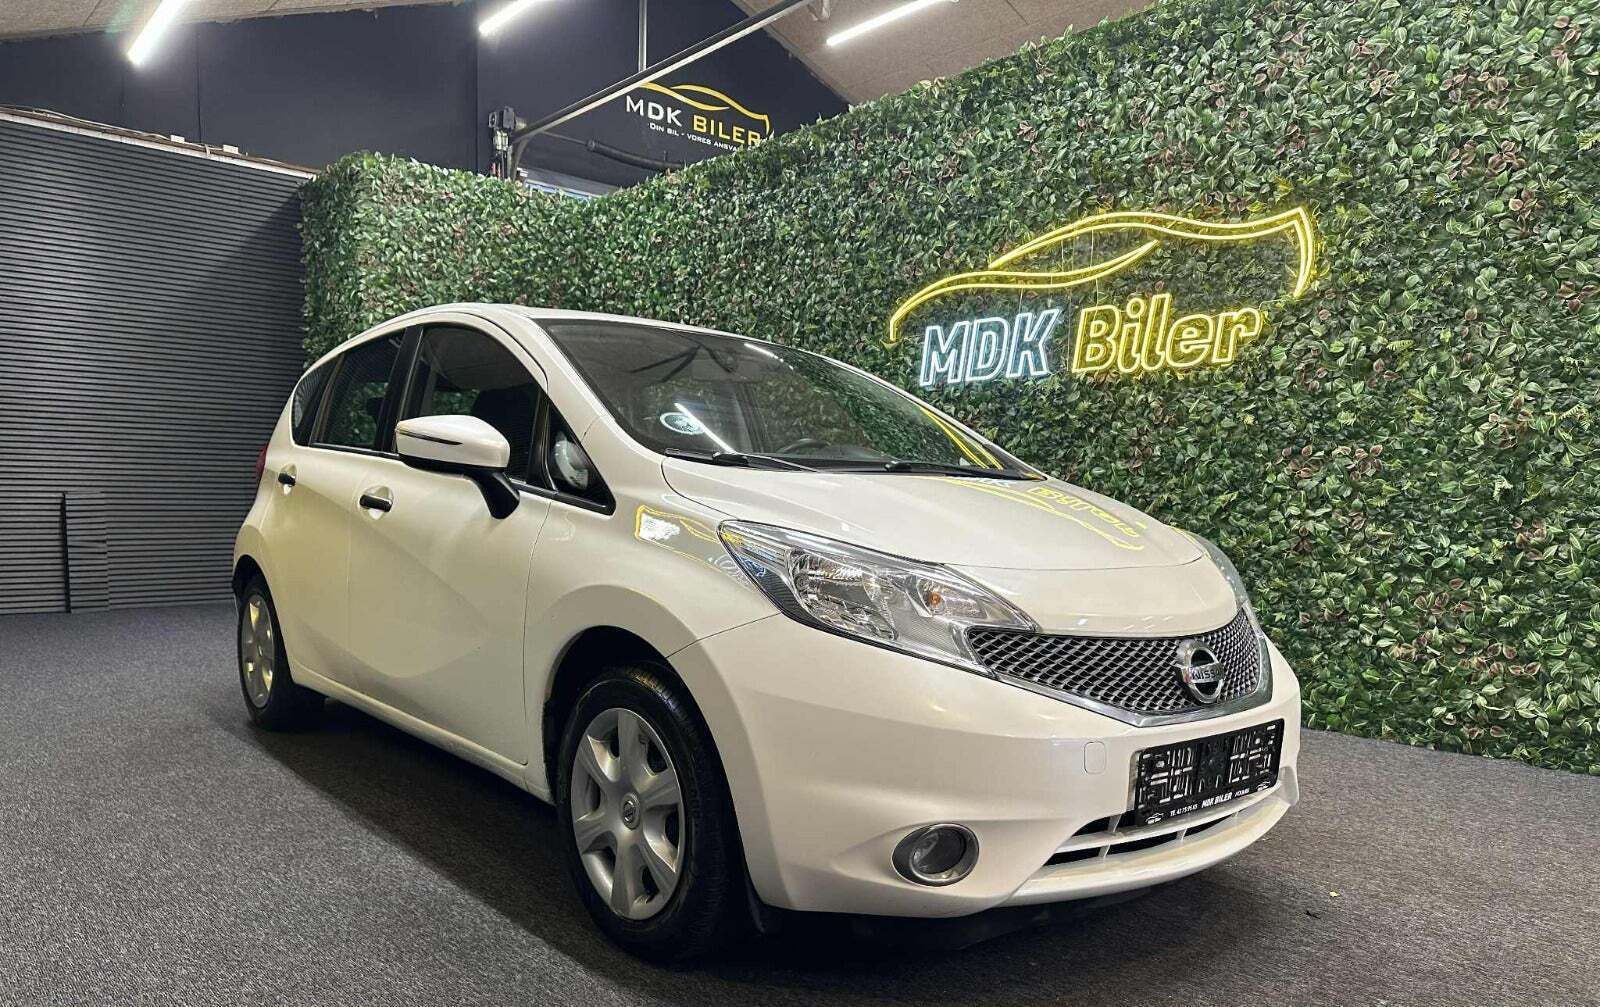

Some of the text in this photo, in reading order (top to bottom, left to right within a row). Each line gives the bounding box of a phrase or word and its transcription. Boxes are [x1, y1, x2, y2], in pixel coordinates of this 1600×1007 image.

[626, 95, 762, 149] MDK BILER
[667, 127, 680, 137] BIL
[919, 293, 1263, 387] MDK Biler
